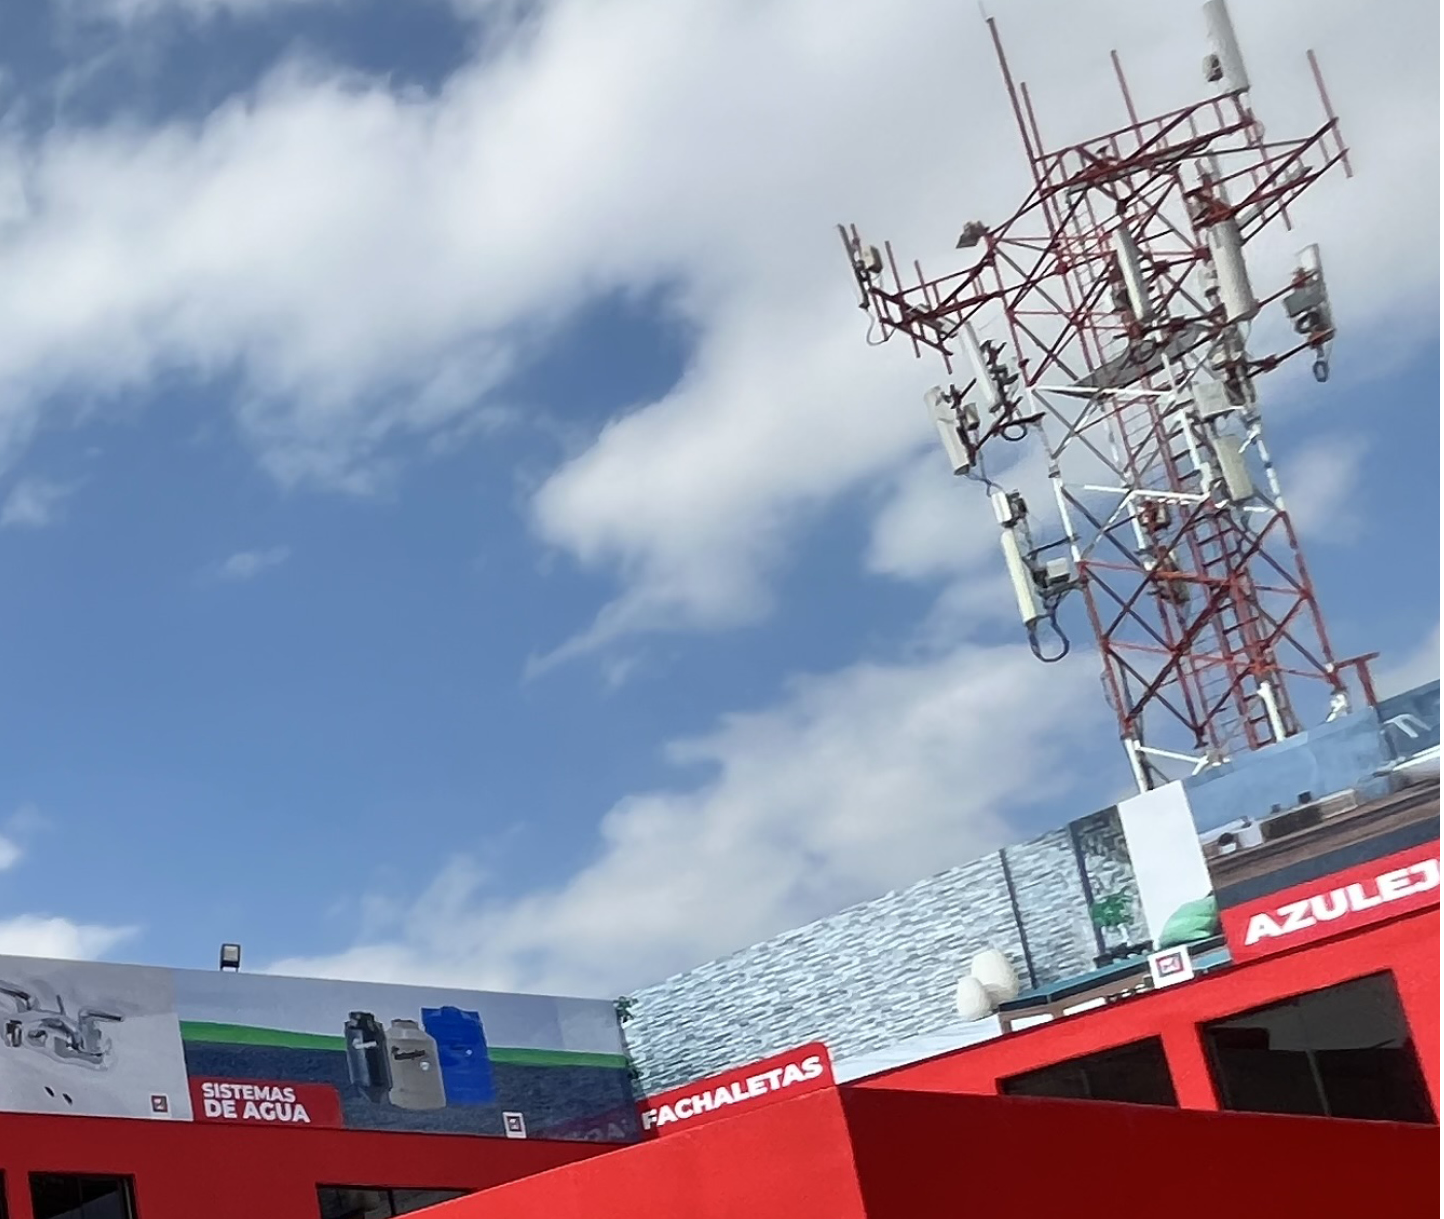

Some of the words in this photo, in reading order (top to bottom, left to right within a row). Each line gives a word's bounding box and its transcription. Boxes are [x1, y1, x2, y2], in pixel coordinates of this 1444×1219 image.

[202, 1082, 296, 1103] SISTEMAS
[641, 1056, 824, 1131] FACHALETAS
[203, 1099, 237, 1119] DE
[243, 1101, 311, 1123] AGUA
